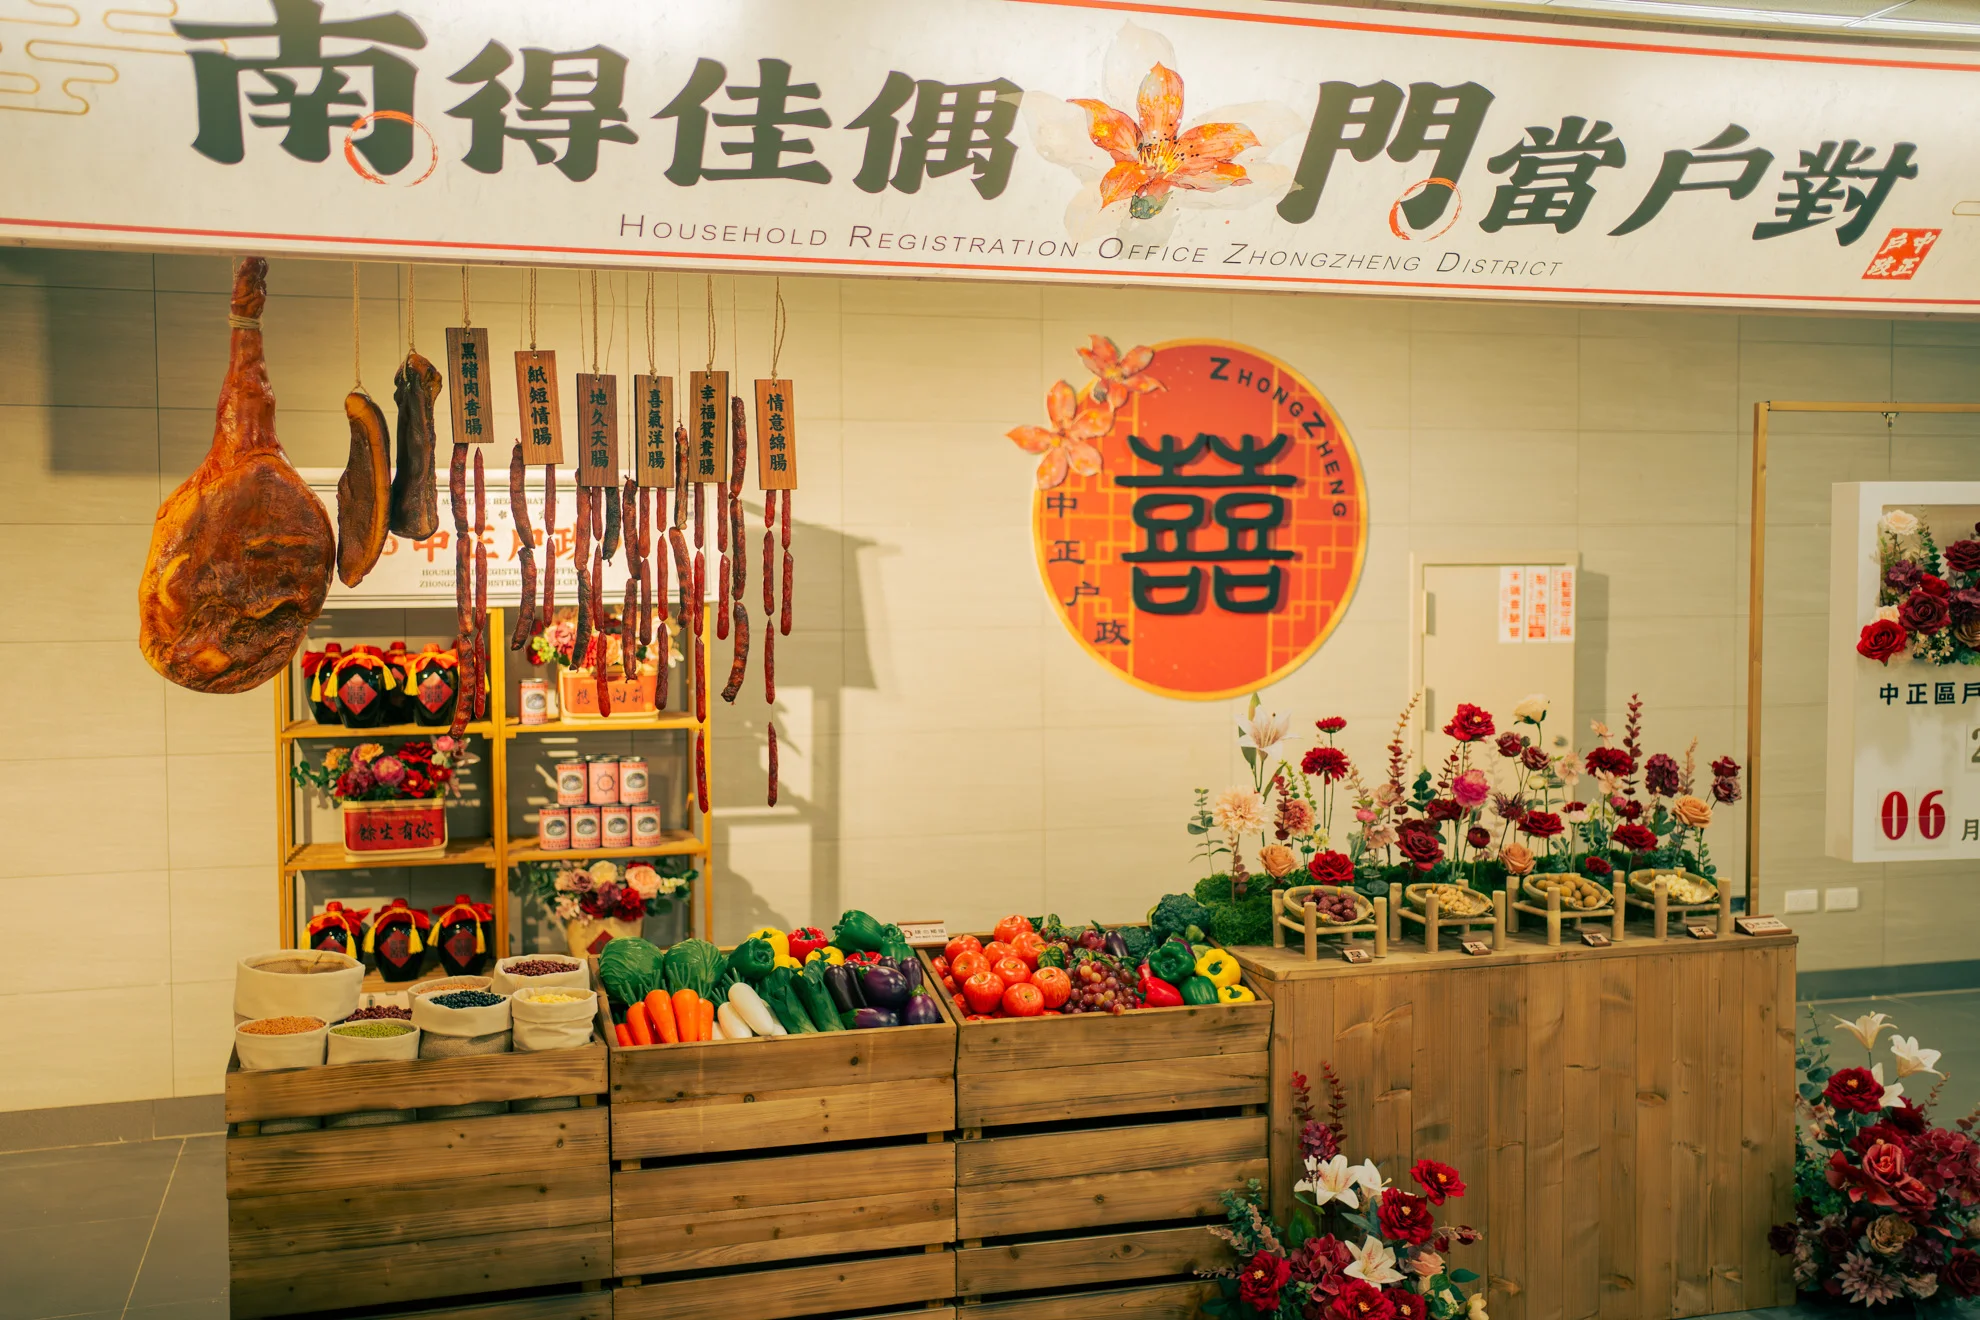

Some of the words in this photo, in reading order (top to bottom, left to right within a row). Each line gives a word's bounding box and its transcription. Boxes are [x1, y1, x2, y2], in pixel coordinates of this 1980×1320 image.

[170, 0, 1025, 200] 南得佳偶
[461, 342, 483, 436] 黑豬肉香腸
[528, 365, 552, 446] 紙短情腸
[589, 388, 609, 469] 地久天腸
[647, 388, 666, 470] 喜氣洋腸
[698, 383, 716, 476] 幸福鴛鴦腸
[766, 392, 788, 473] 情意綿腸
[358, 820, 435, 842] 餘生有你
[1881, 790, 1946, 840] 06
[1961, 818, 1979, 841] 月
